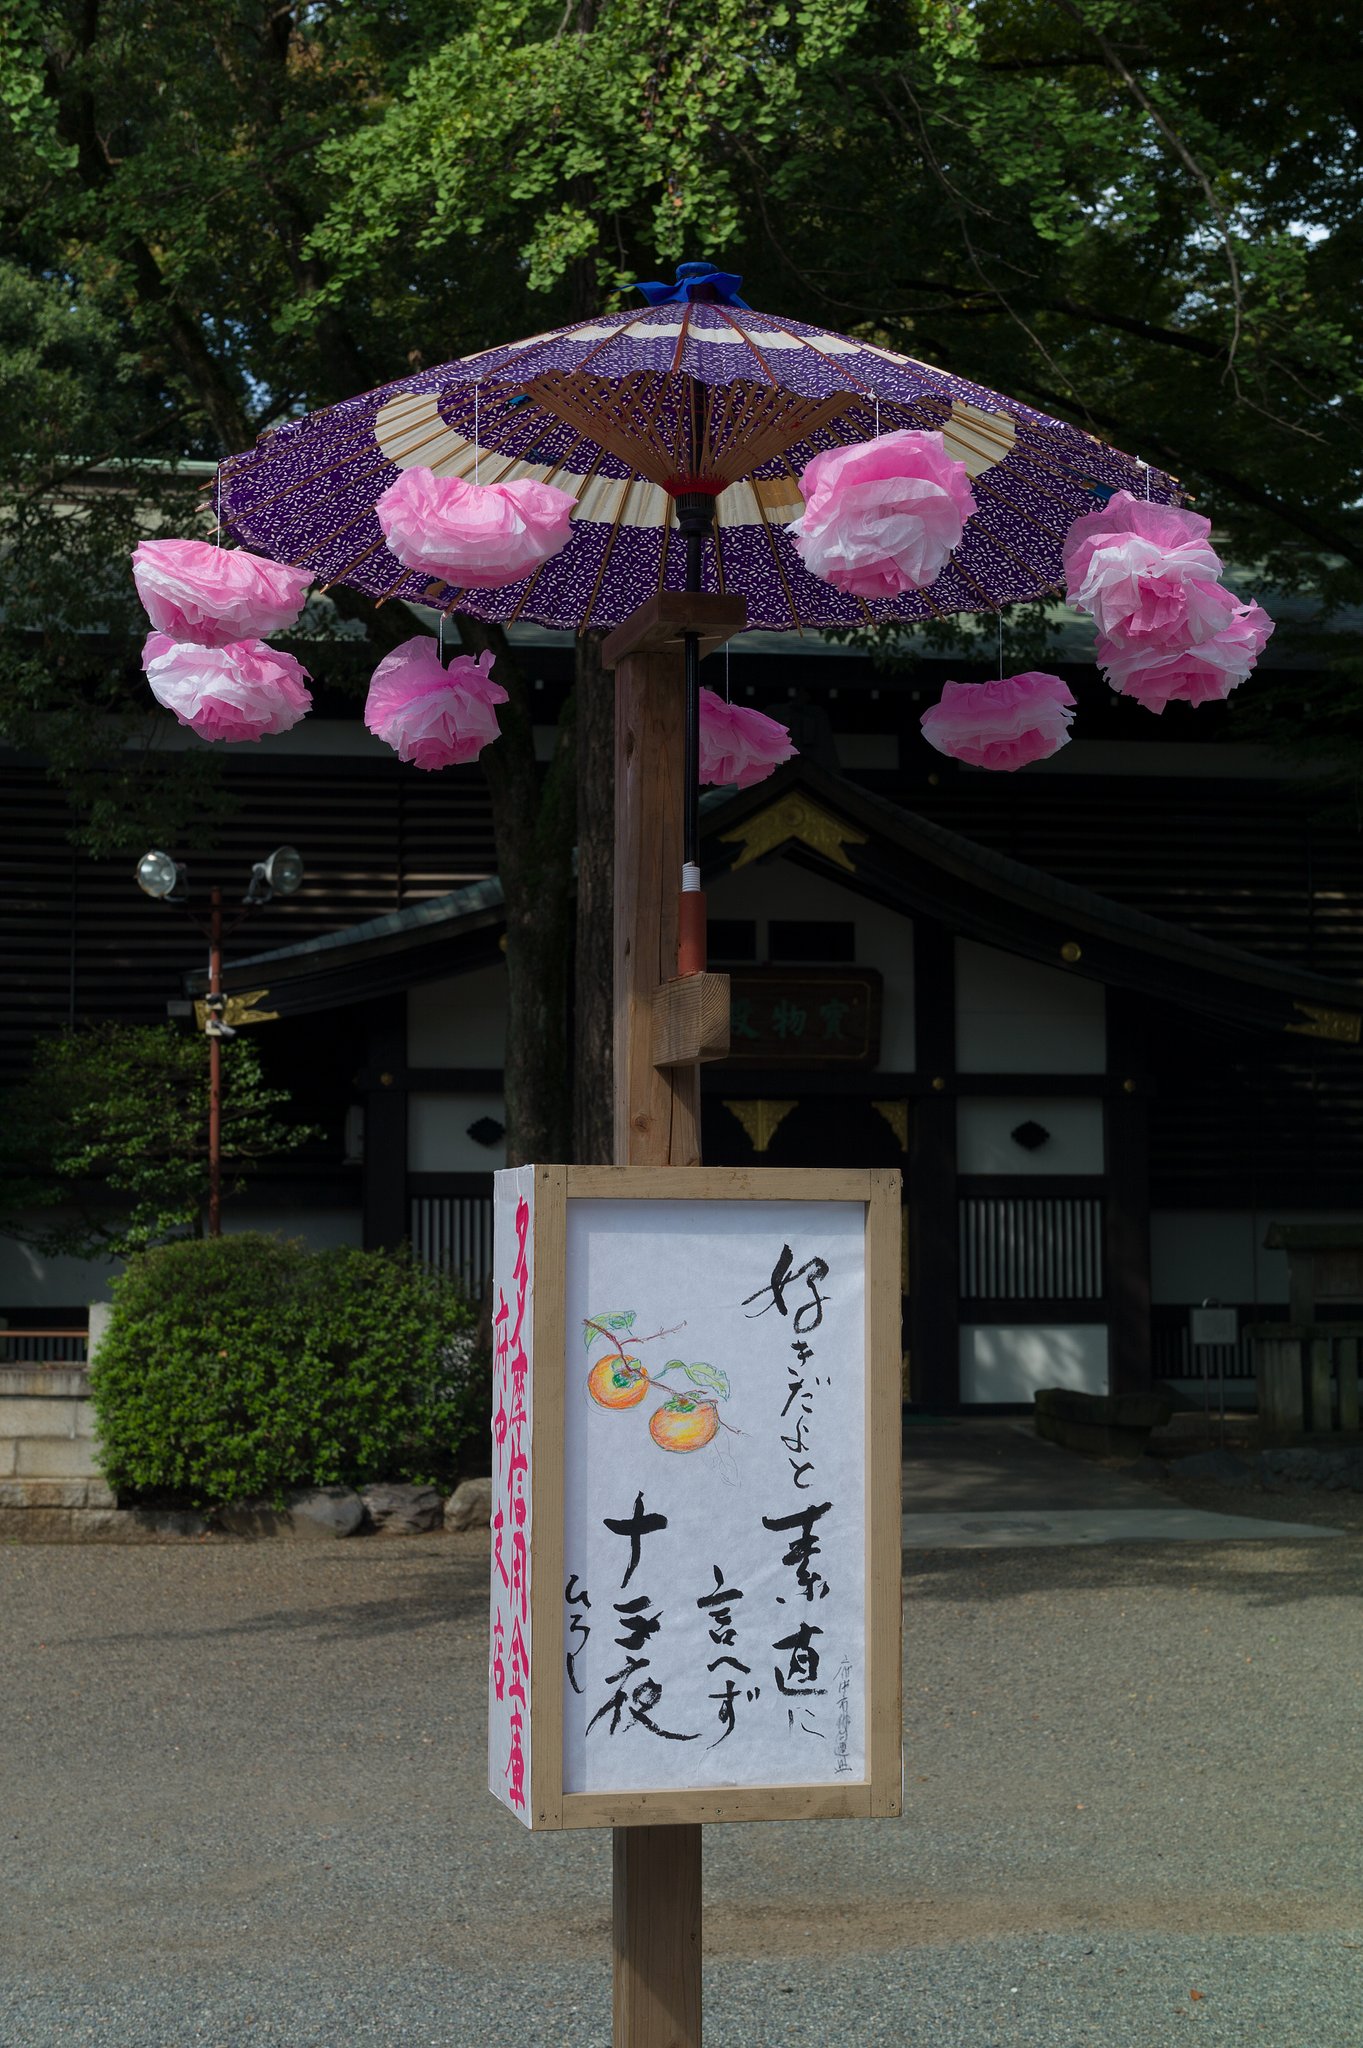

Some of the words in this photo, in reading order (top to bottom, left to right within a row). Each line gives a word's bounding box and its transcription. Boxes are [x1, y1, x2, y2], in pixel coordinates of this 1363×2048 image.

[493, 1286, 509, 1702] 府中支店
[506, 1195, 529, 1811] 多摩信用金庫
